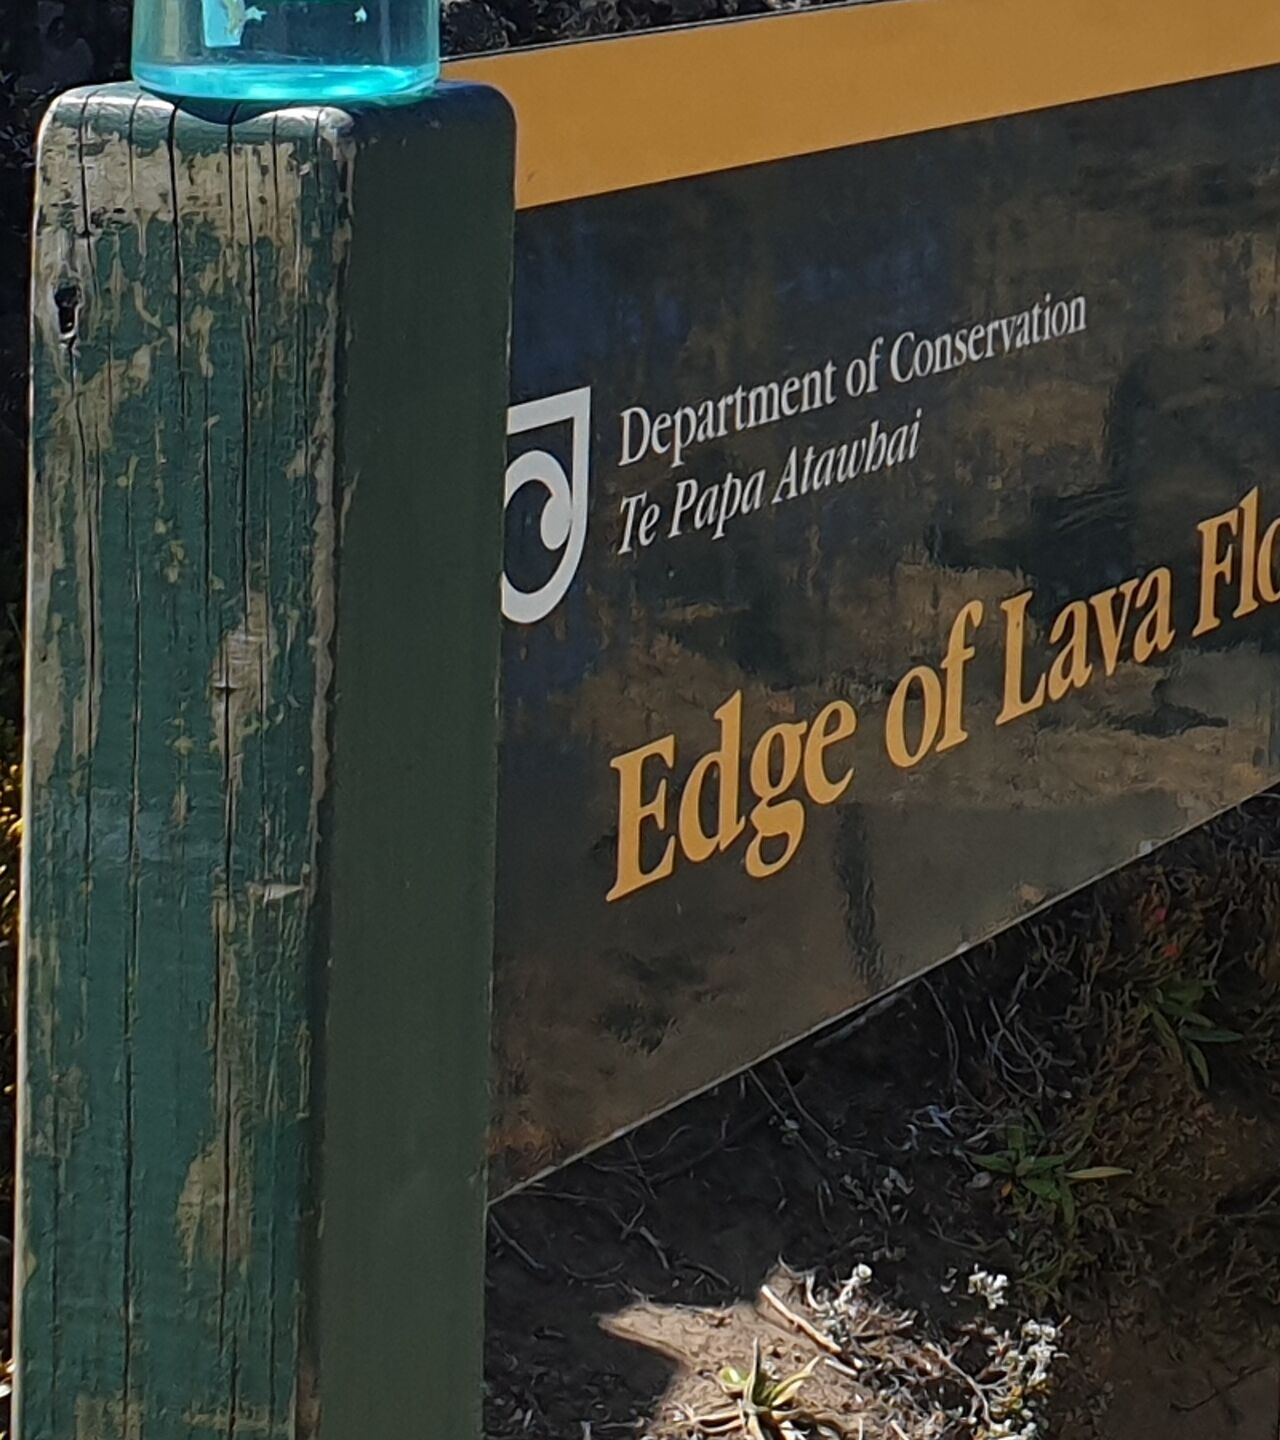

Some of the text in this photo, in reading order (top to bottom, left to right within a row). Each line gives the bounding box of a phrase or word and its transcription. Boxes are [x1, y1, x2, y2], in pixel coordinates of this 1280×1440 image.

[618, 292, 1087, 467] Department of Conservation
[617, 408, 923, 556] Te Papa Atawhai
[606, 690, 857, 902] Edge
[885, 599, 983, 769] of
[997, 564, 1175, 726] Lava
